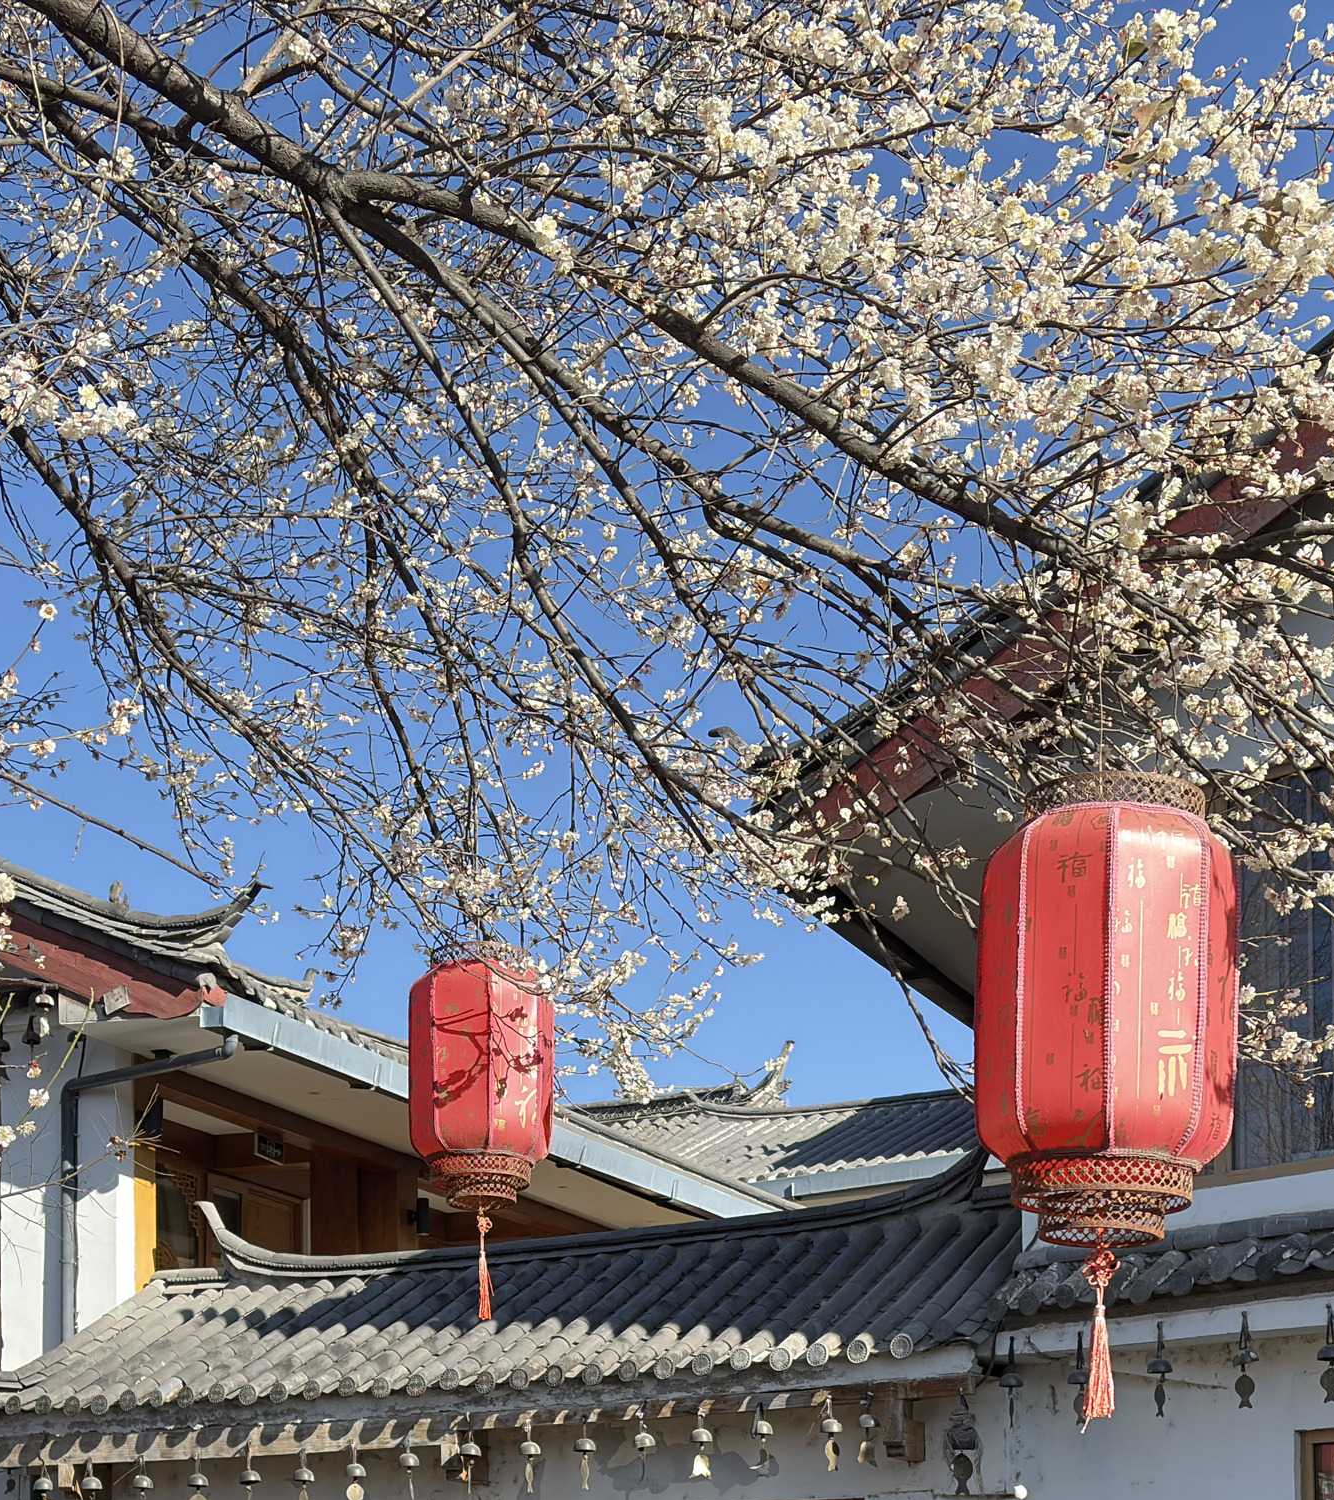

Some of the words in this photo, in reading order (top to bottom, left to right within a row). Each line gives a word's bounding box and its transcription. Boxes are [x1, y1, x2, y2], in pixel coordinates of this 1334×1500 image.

[1057, 852, 1092, 884] 福
[1127, 857, 1146, 889] 福
[1167, 913, 1187, 940] 福
[1062, 972, 1088, 1003] 福
[1168, 970, 1186, 1002] 福
